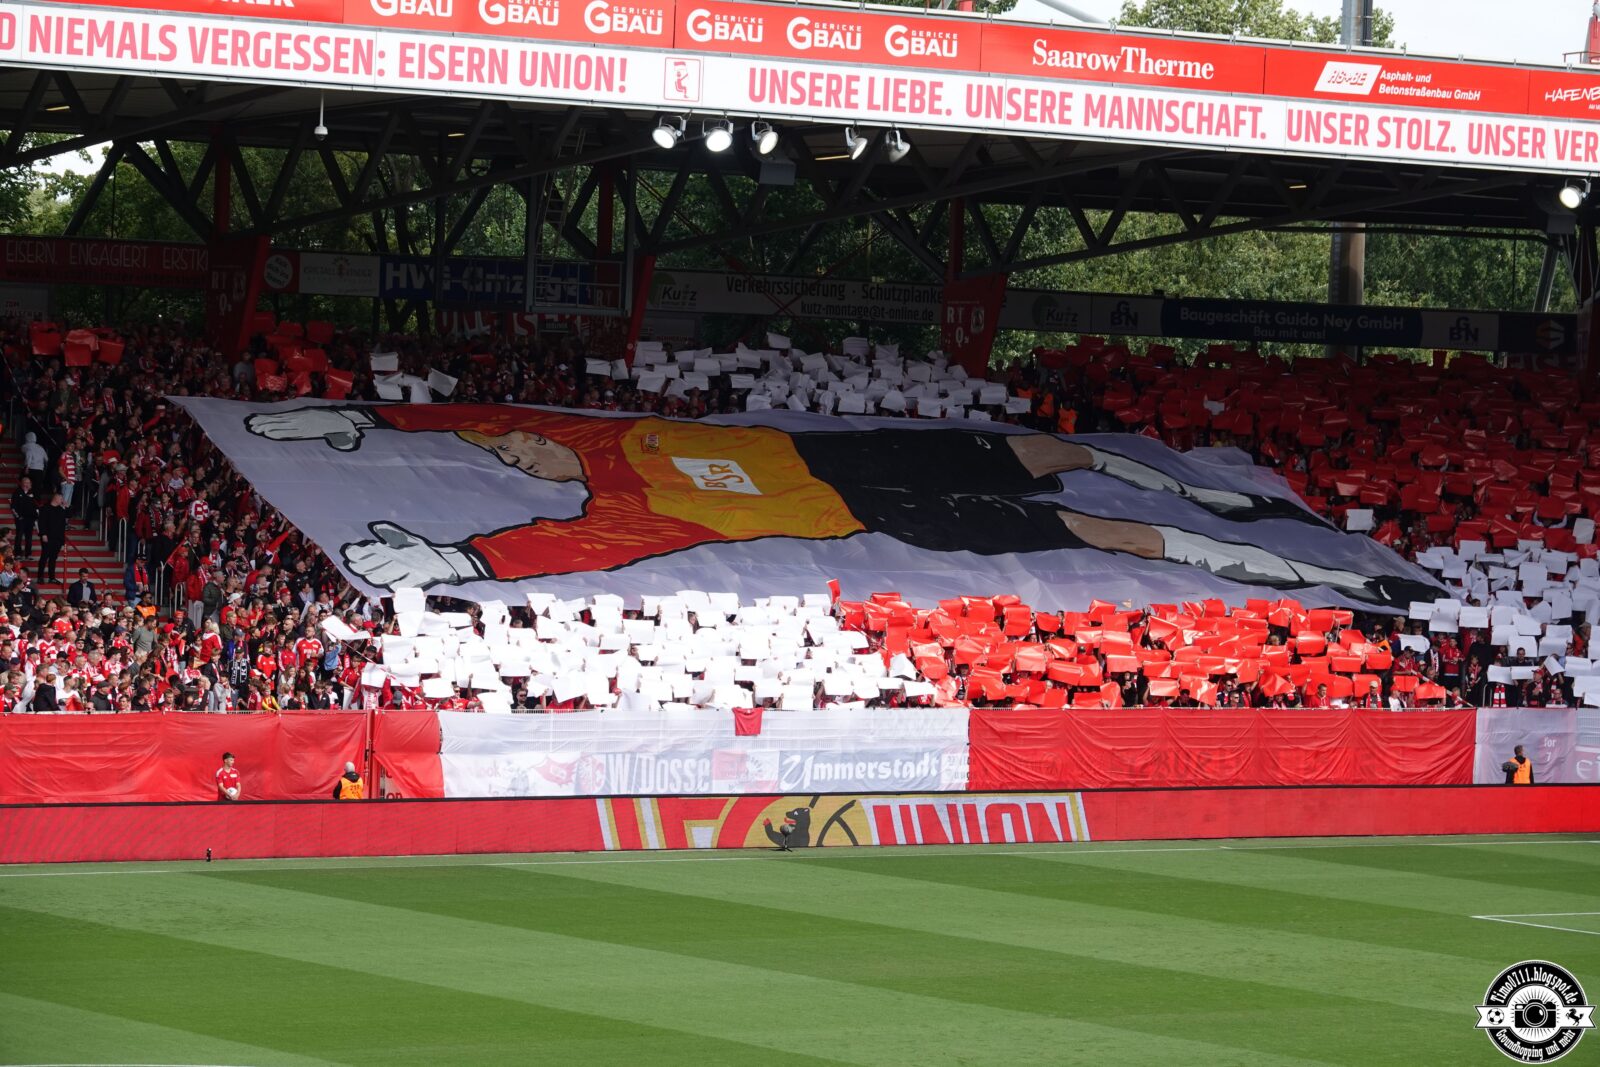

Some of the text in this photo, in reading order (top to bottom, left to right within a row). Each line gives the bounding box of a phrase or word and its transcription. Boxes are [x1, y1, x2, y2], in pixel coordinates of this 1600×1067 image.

[613, 6, 663, 16] GERICKE
[714, 14, 763, 25] GERICKE
[814, 22, 862, 33] GERICKE
[911, 30, 958, 41] GERICKE
[29, 14, 177, 61] NIEMALS
[188, 26, 385, 76] VERGESSEN:
[399, 42, 509, 83] EISERN
[519, 50, 628, 93] UNION!
[1032, 38, 1214, 80] SaarowTherme
[1379, 69, 1431, 83] Asphalt- und
[1378, 83, 1481, 101] Betonstraßenbau GmbH
[749, 67, 1599, 163] UNSERE LIEBE. UNSERE MANNSCHAFT. UNSER STOLZ. UNSER VER
[662, 284, 697, 301] Kutz
[726, 276, 846, 301] Verkehrssicherung
[800, 301, 934, 321] kutz-montage@t-online.de
[1179, 306, 1404, 332] Baugeschäft Guido Ney GmbH
[1253, 327, 1326, 339] Bau mit uns!
